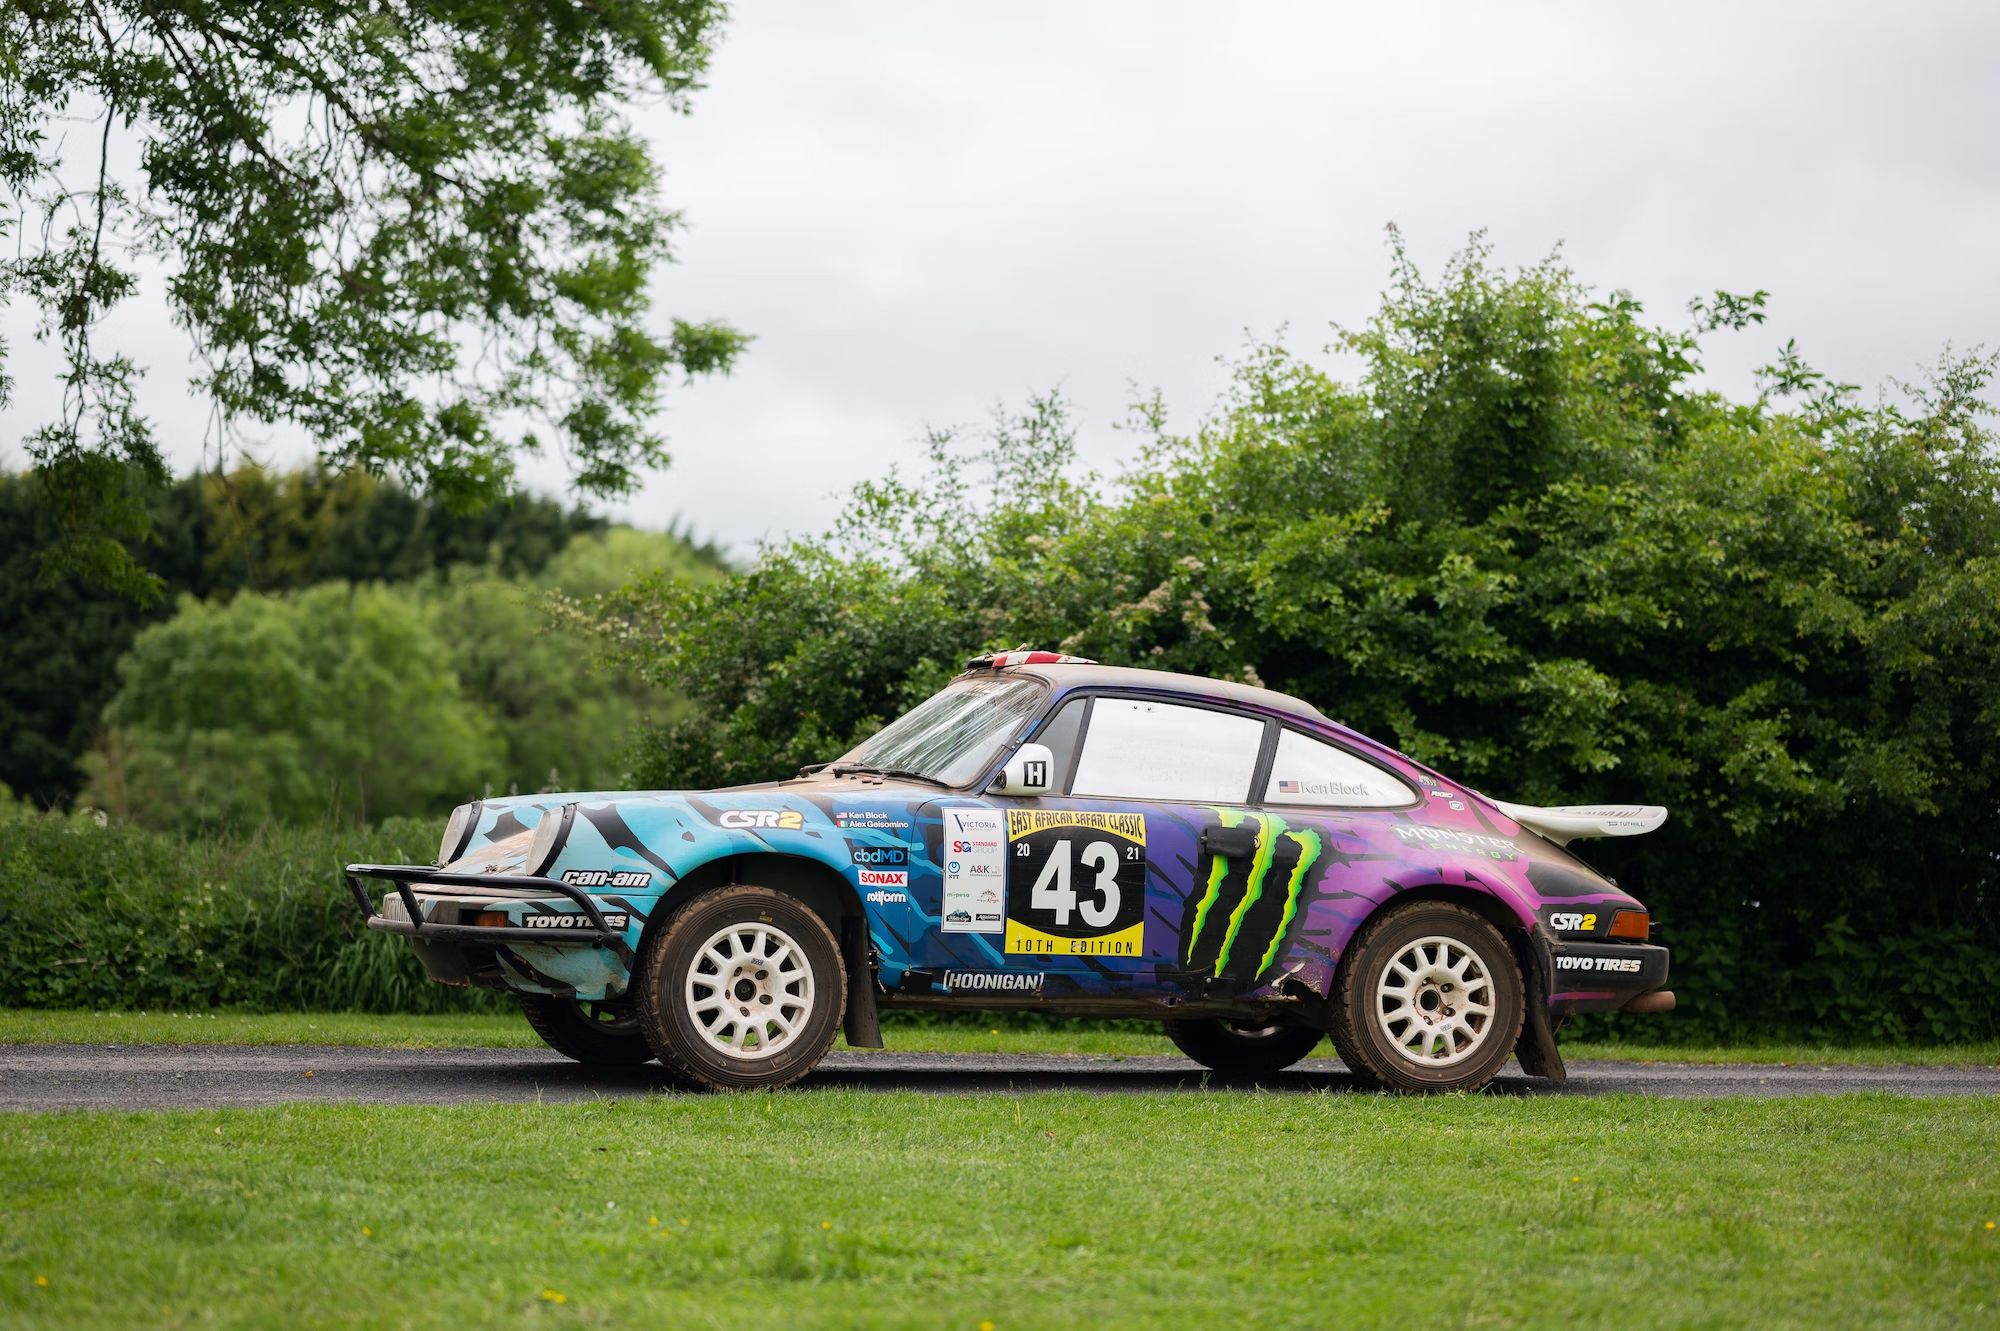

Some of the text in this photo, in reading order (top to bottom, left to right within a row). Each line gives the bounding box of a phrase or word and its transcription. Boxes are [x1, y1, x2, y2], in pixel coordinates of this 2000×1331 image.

[1028, 763, 1042, 785] H
[1301, 781, 1369, 796] Ken Block
[719, 810, 803, 829] CSR2
[962, 821, 997, 829] VICTORIA
[1010, 811, 1144, 840] EAST AFRICAN SAFARI CLASSIC
[853, 849, 904, 863] cbdMD
[1016, 843, 1030, 857] 20
[1126, 846, 1139, 860] 21
[970, 865, 990, 874] A&K
[562, 871, 651, 887] can-am
[861, 872, 904, 885] SONAX
[1031, 839, 1121, 928] 43
[867, 891, 907, 906] rotiform
[525, 915, 627, 928] TOYO TIES
[1550, 912, 1597, 931] CSR2
[1016, 939, 1133, 954] 10TH EDITION
[1556, 956, 1642, 972] TOYO TIRES
